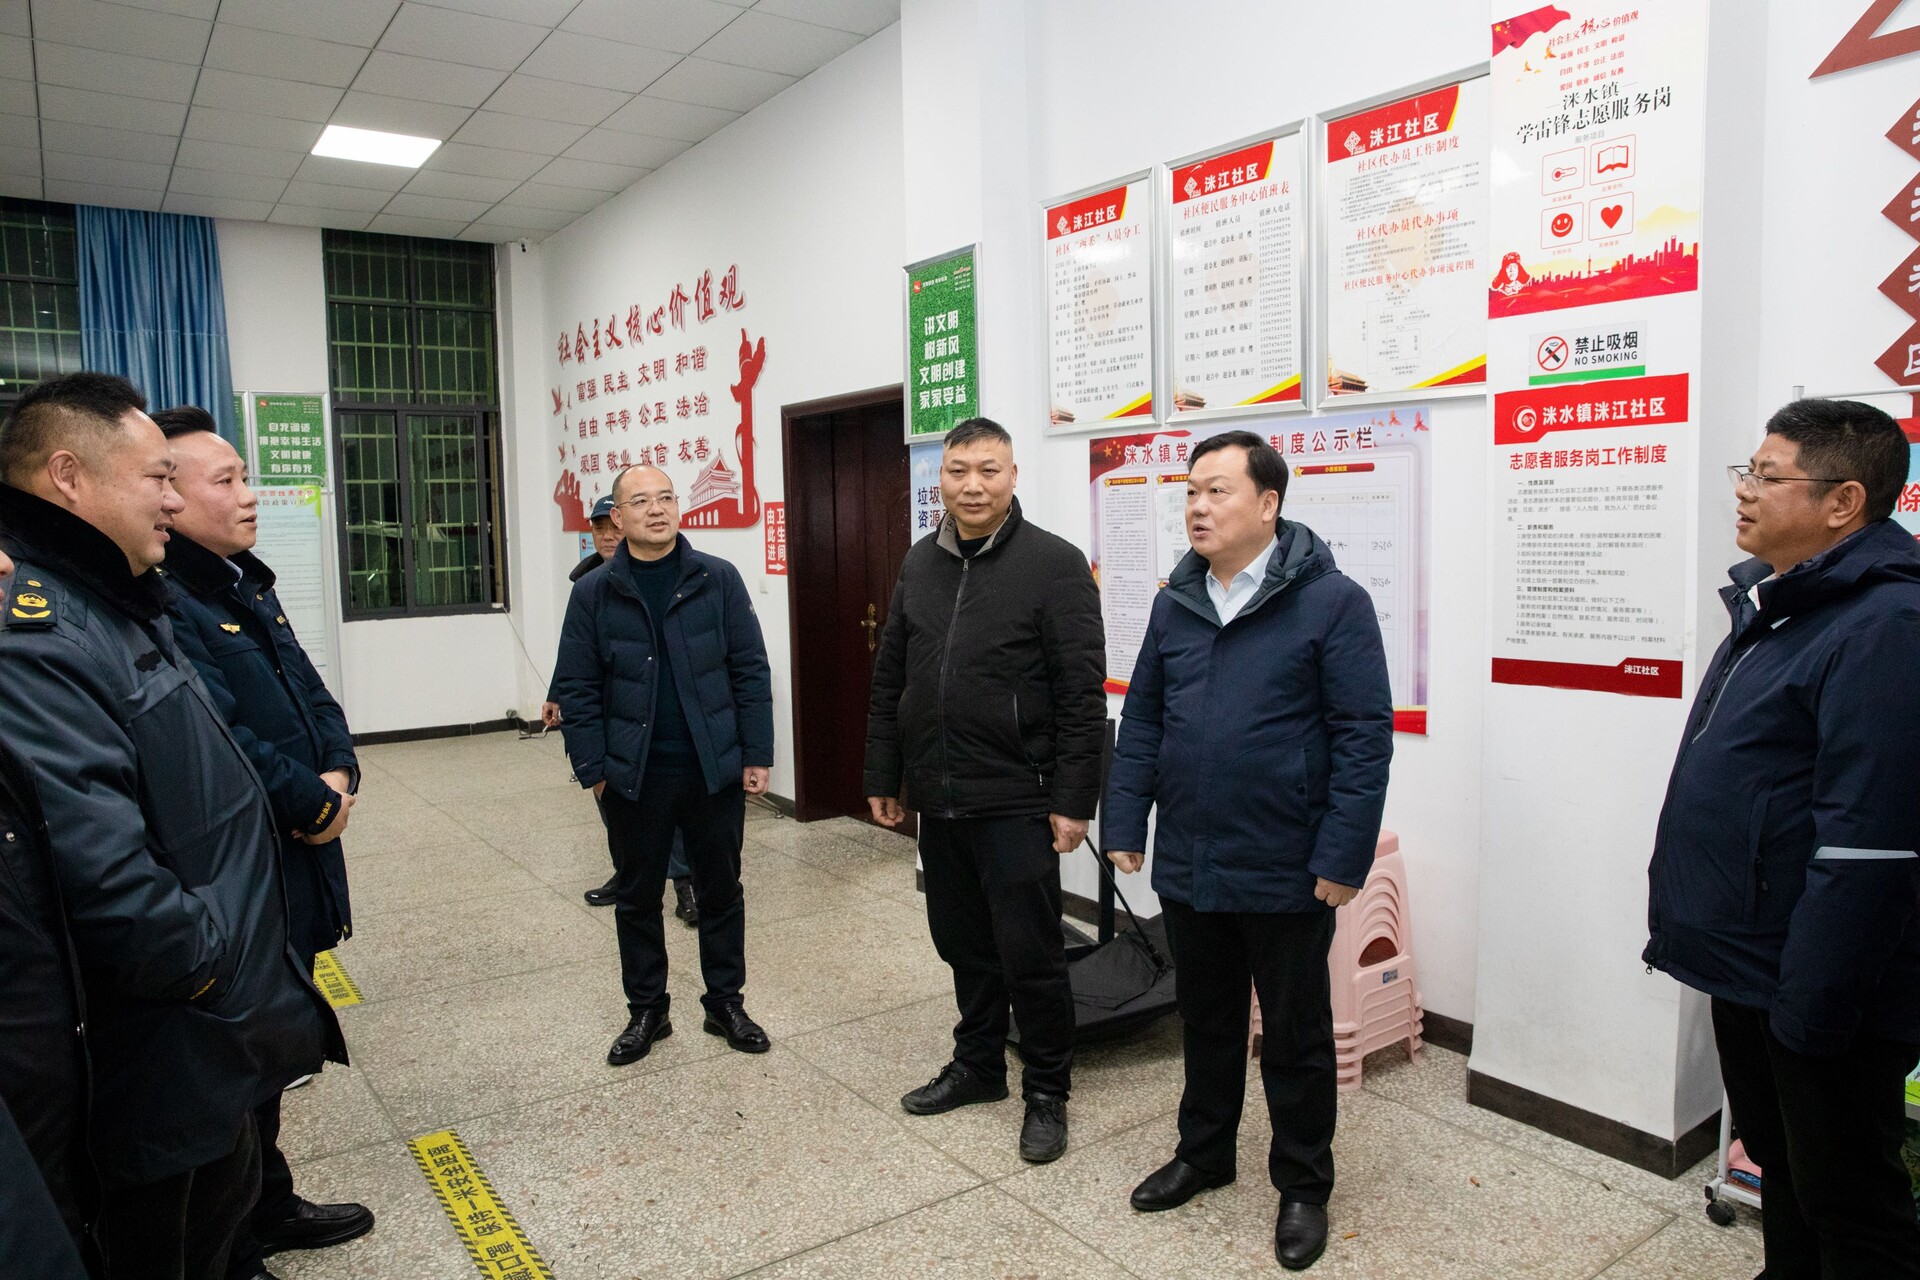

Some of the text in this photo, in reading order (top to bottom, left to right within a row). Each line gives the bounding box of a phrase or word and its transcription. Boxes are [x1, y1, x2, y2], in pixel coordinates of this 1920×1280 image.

[1549, 11, 1638, 46] 社会主义核心价值观
[1563, 81, 1619, 111] 洣水镇
[1370, 112, 1439, 148] 洣江社区
[1517, 86, 1671, 144] 学雷锋志愿服务岗
[1357, 136, 1459, 174] 社区代办员工作制度
[1204, 163, 1258, 193] 洣江社区
[1184, 181, 1289, 220] 社区便民服务中心值班表
[1073, 205, 1116, 230] 洣江社区
[1357, 208, 1459, 240] 社区代办员代办事项
[1344, 260, 1475, 291] 社区便民服务中心代办事项流程图
[557, 263, 745, 367] 社会主义核心价值观
[925, 310, 958, 336] 讲文明
[925, 335, 959, 360] 树新风
[1575, 331, 1638, 355] 禁止吸烟
[919, 359, 966, 386] 文明创建
[1575, 351, 1638, 366] NO SMOKING
[577, 347, 707, 402] 富强 民主 文明 和谐
[919, 385, 966, 410] 家家受益
[1542, 397, 1665, 426] 洣水镇洣江社区
[578, 392, 709, 438] 自由 平等 公正 法治
[580, 437, 709, 474] 爱国 敬业 诚信 友善
[1270, 426, 1373, 456] 制度公示栏
[1510, 444, 1667, 470] 志愿者服务岗工作制度
[1624, 664, 1659, 676] 洣江社区
[427, 1143, 504, 1237] 保持一米安全距离
